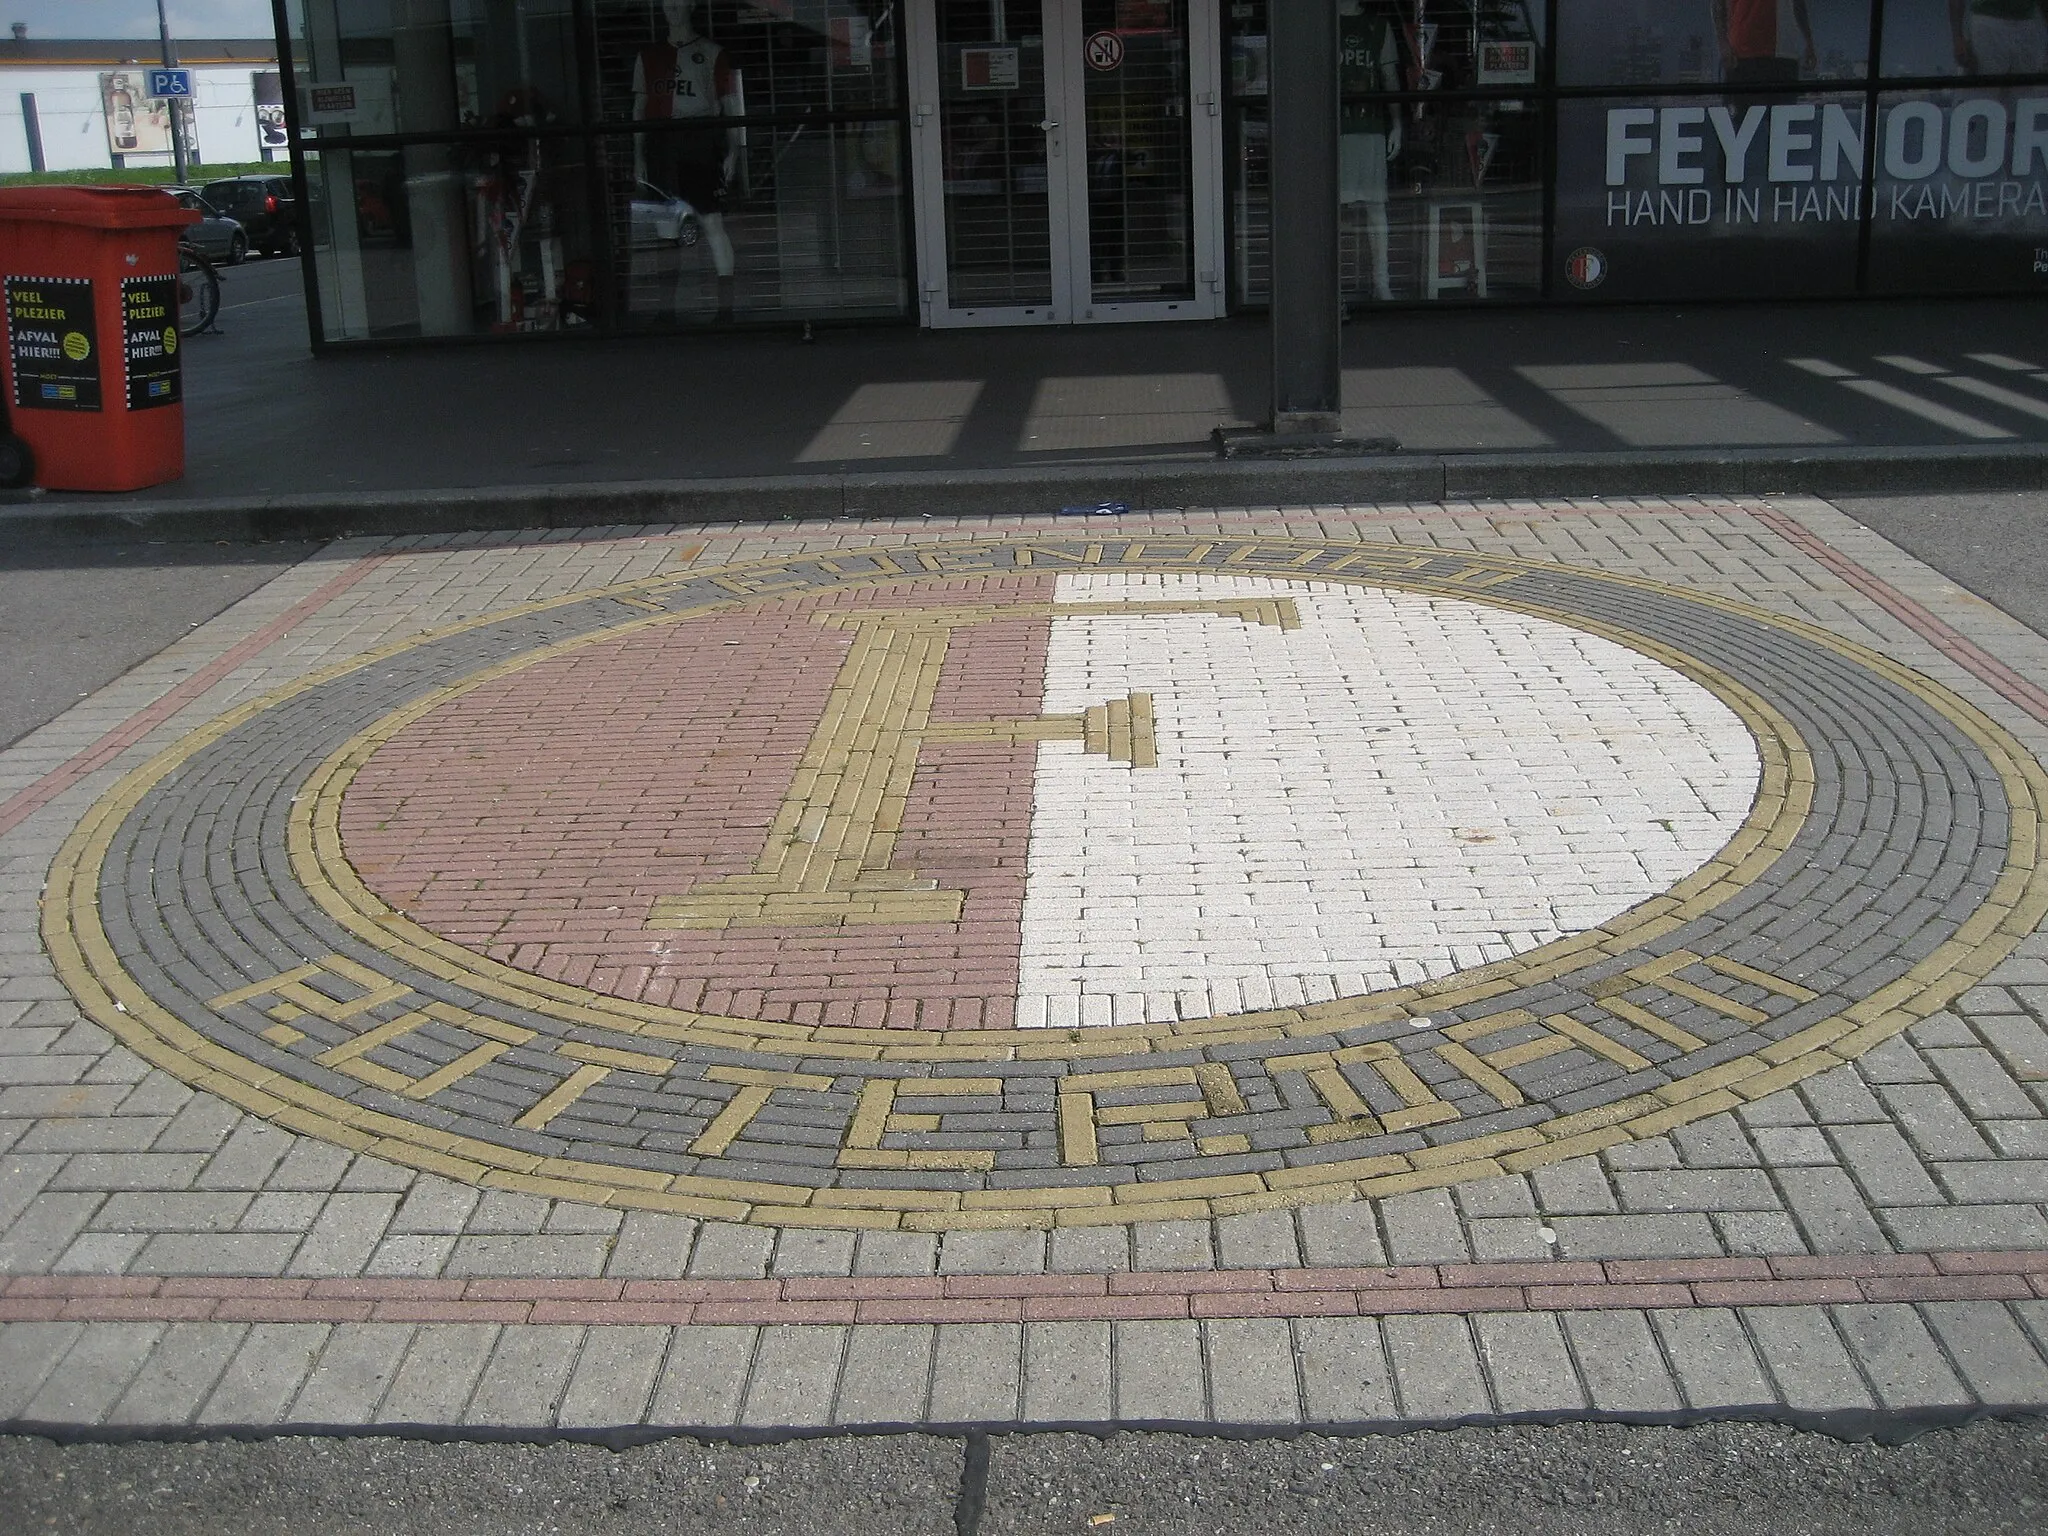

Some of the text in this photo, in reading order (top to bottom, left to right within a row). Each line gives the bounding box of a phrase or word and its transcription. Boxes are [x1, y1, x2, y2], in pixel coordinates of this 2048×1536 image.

[155, 75, 168, 93] P
[654, 79, 697, 97] OPEL
[1606, 181, 2047, 227] HAND IN HAND KAMERA
[12, 291, 44, 304] VEEL
[127, 291, 151, 304] VEEL
[15, 307, 66, 321] PLEZIER
[129, 305, 166, 320] PLEZIER
[17, 329, 58, 344] AFVAL
[130, 330, 161, 344] AFVAL
[19, 346, 61, 360] HIER!!!
[131, 345, 163, 360] HIER!!!
[211, 949, 1818, 1171] ROTTERDAM
